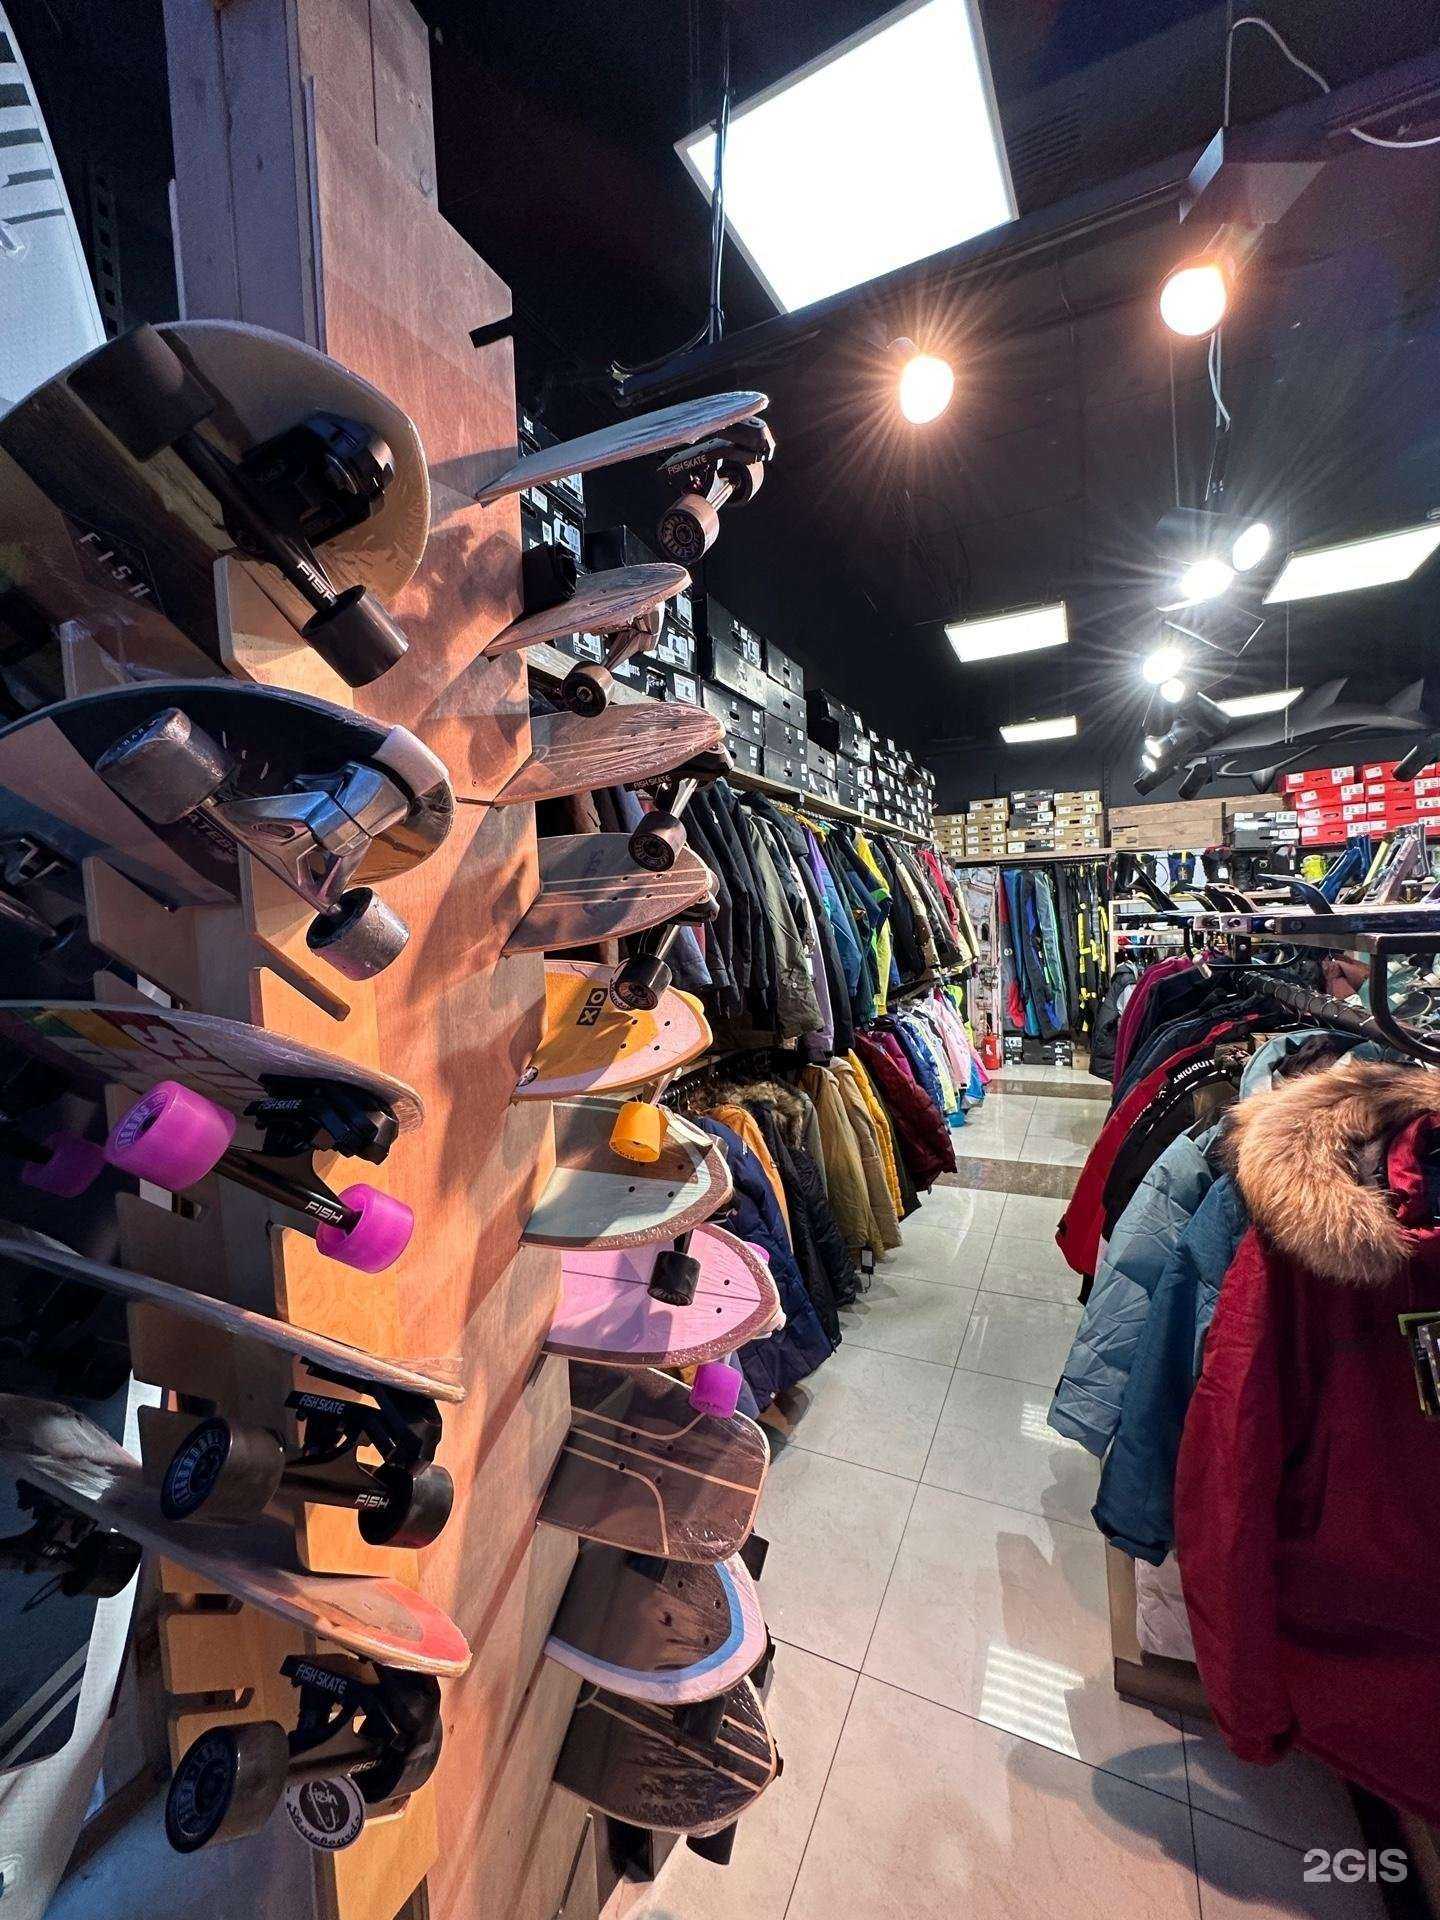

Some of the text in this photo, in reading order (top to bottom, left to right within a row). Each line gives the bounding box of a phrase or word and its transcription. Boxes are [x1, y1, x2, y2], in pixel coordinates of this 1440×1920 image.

[667, 454, 708, 475] FISH SKATE
[79, 532, 151, 598] FISH
[649, 774, 671, 786] SKATE
[304, 1200, 343, 1224] FISH
[299, 1394, 346, 1415] FISH SKATE
[354, 1493, 390, 1509] FISH
[296, 1662, 347, 1695] FISH SKATE
